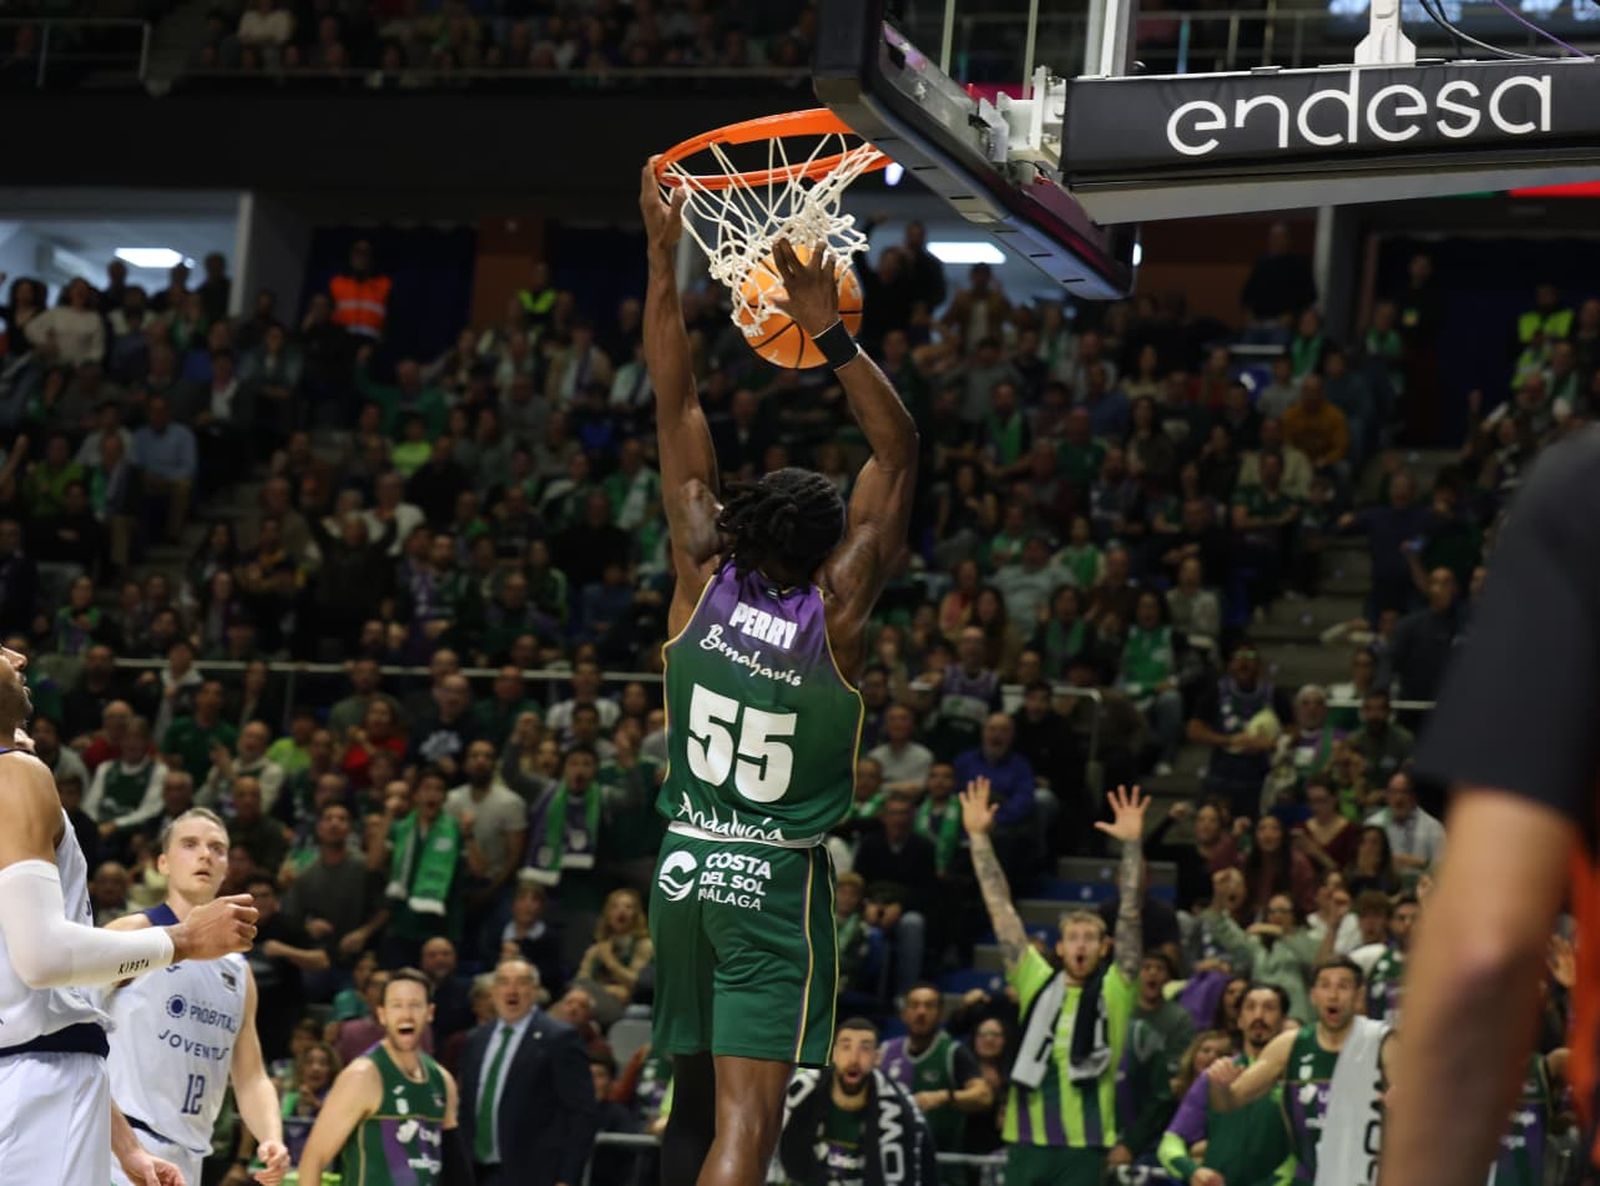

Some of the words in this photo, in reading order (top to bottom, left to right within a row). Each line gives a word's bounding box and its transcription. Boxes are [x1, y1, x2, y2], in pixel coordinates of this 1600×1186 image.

[1167, 68, 1552, 156] endesa
[728, 602, 798, 649] PERRY
[687, 683, 797, 803] 55
[676, 791, 786, 842] Andalucía
[700, 871, 727, 886] DEL
[731, 875, 766, 896] SOL
[705, 852, 771, 879] COSTA
[697, 886, 762, 911] MÁLAGA
[118, 959, 150, 975] KIPSTA
[181, 1074, 206, 1115] 12
